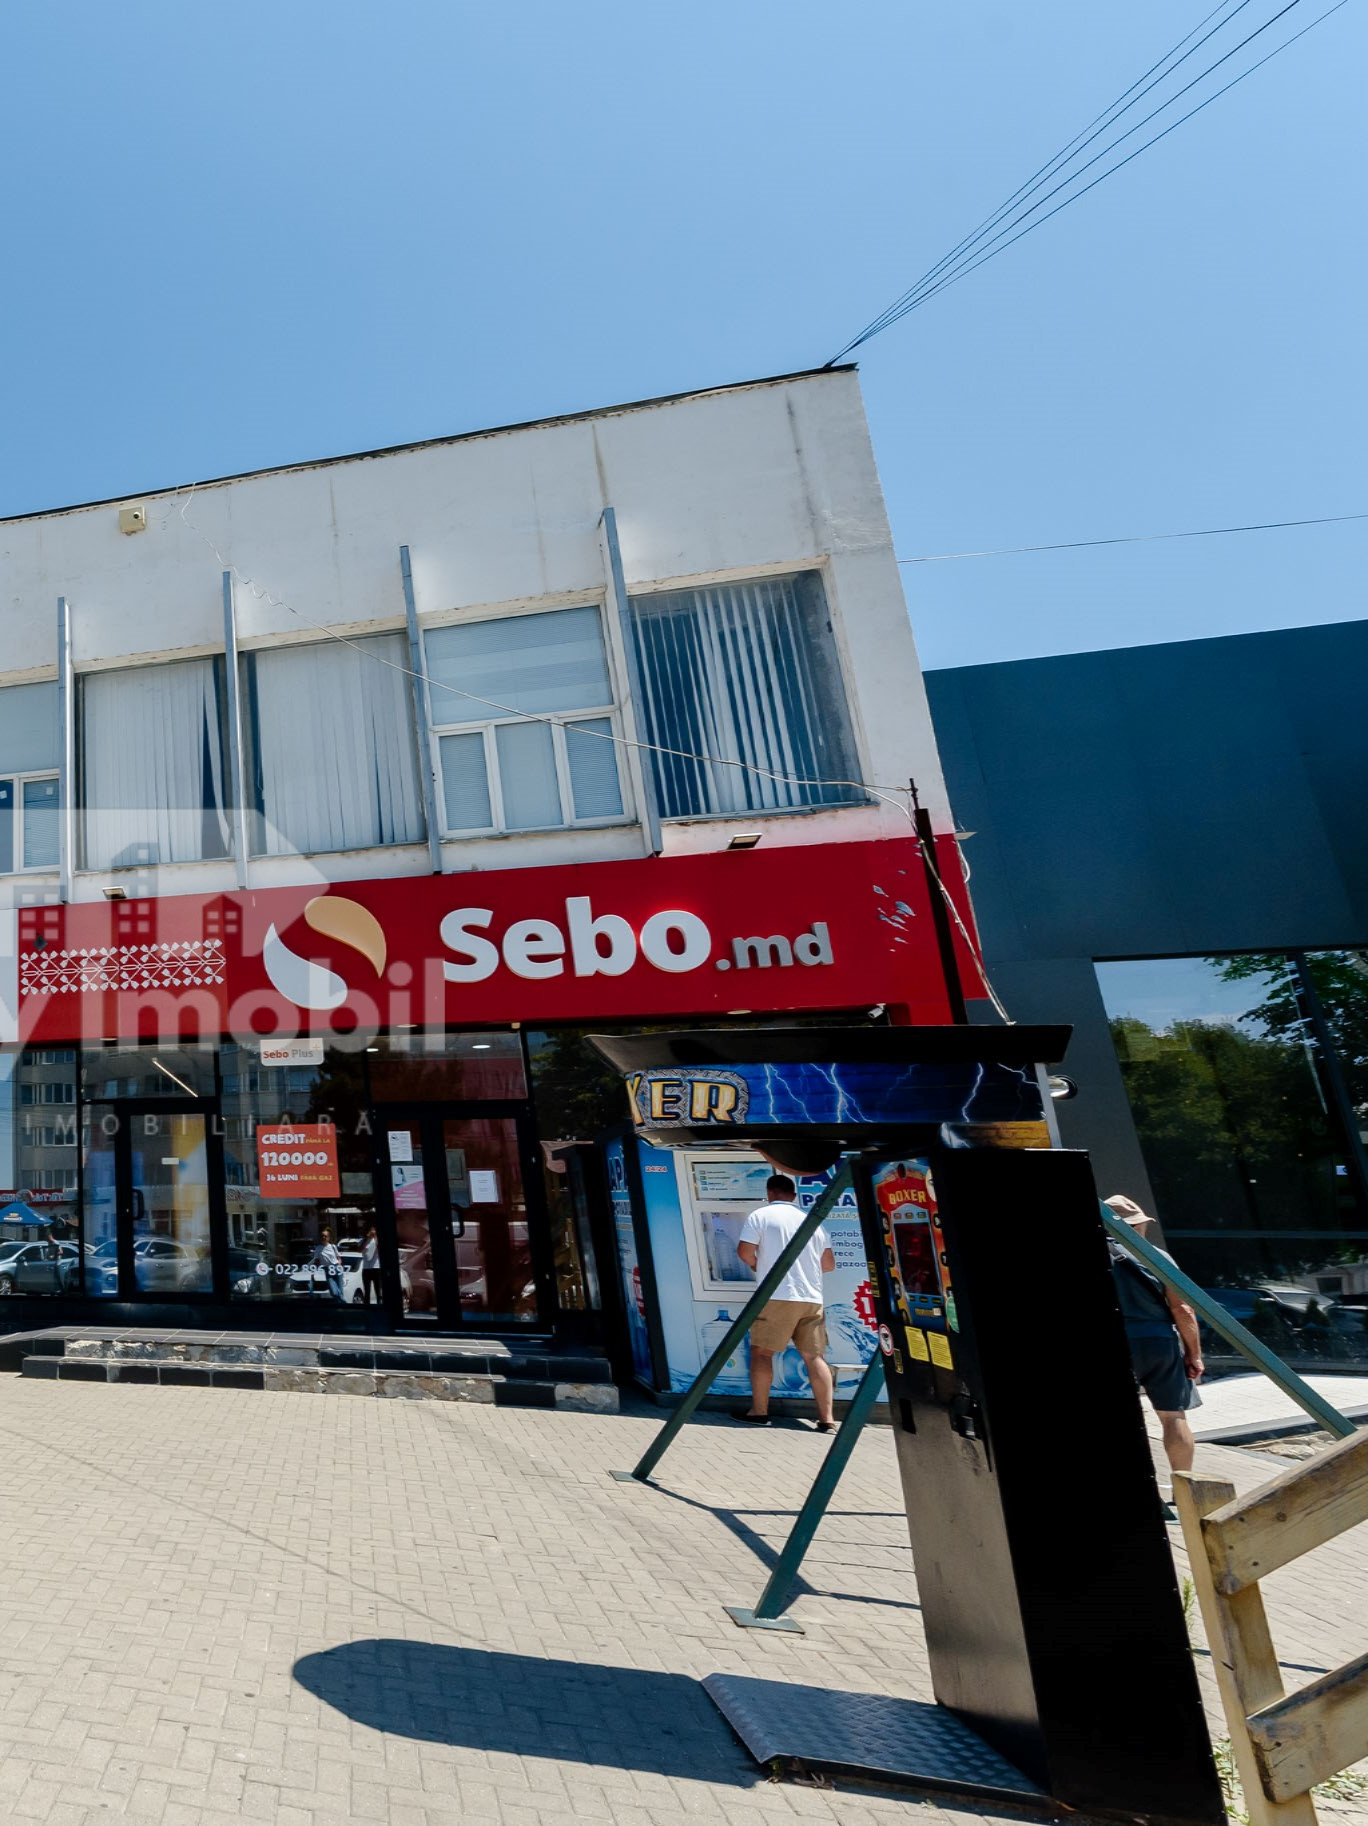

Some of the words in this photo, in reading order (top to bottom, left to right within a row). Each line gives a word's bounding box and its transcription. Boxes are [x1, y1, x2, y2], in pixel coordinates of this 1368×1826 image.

[440, 896, 835, 983] Sebo.md
[263, 1049, 290, 1059] Sebo
[292, 1048, 314, 1058] Plus
[261, 1133, 306, 1145] CREDIT
[261, 1151, 328, 1166] 120000
[277, 1173, 298, 1181] LUNI
[888, 1189, 927, 1205] BOXER
[275, 1263, 298, 1275] 022
[328, 1264, 352, 1276] 897
